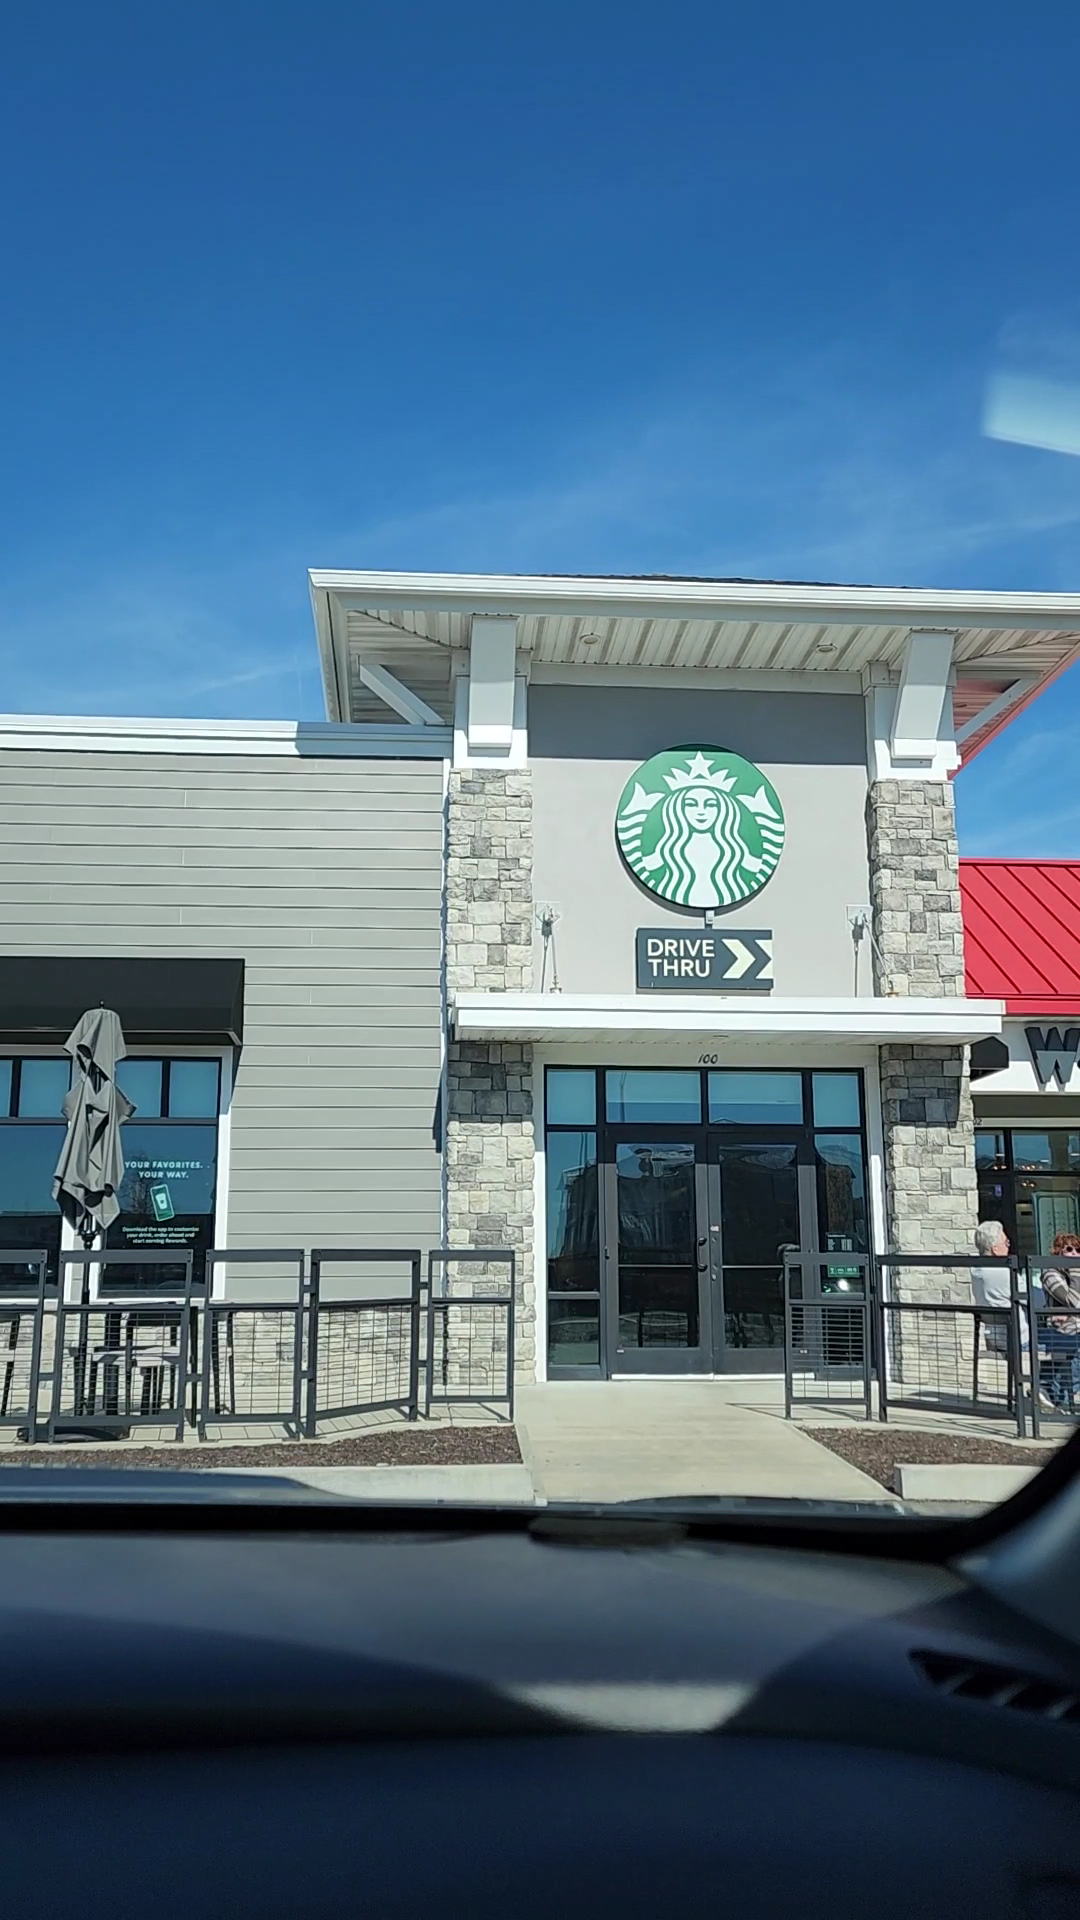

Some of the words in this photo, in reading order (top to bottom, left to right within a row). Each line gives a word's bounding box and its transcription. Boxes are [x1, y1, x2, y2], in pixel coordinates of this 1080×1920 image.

[647, 938, 715, 957] DRIVE
[647, 958, 711, 978] THRU
[698, 1054, 718, 1064] 100
[1024, 1026, 1080, 1085] W
[125, 1161, 150, 1169] YOUR
[152, 1161, 203, 1169] FAVORITES.
[139, 1171, 164, 1179] YOUR
[166, 1171, 189, 1179] WAY.
